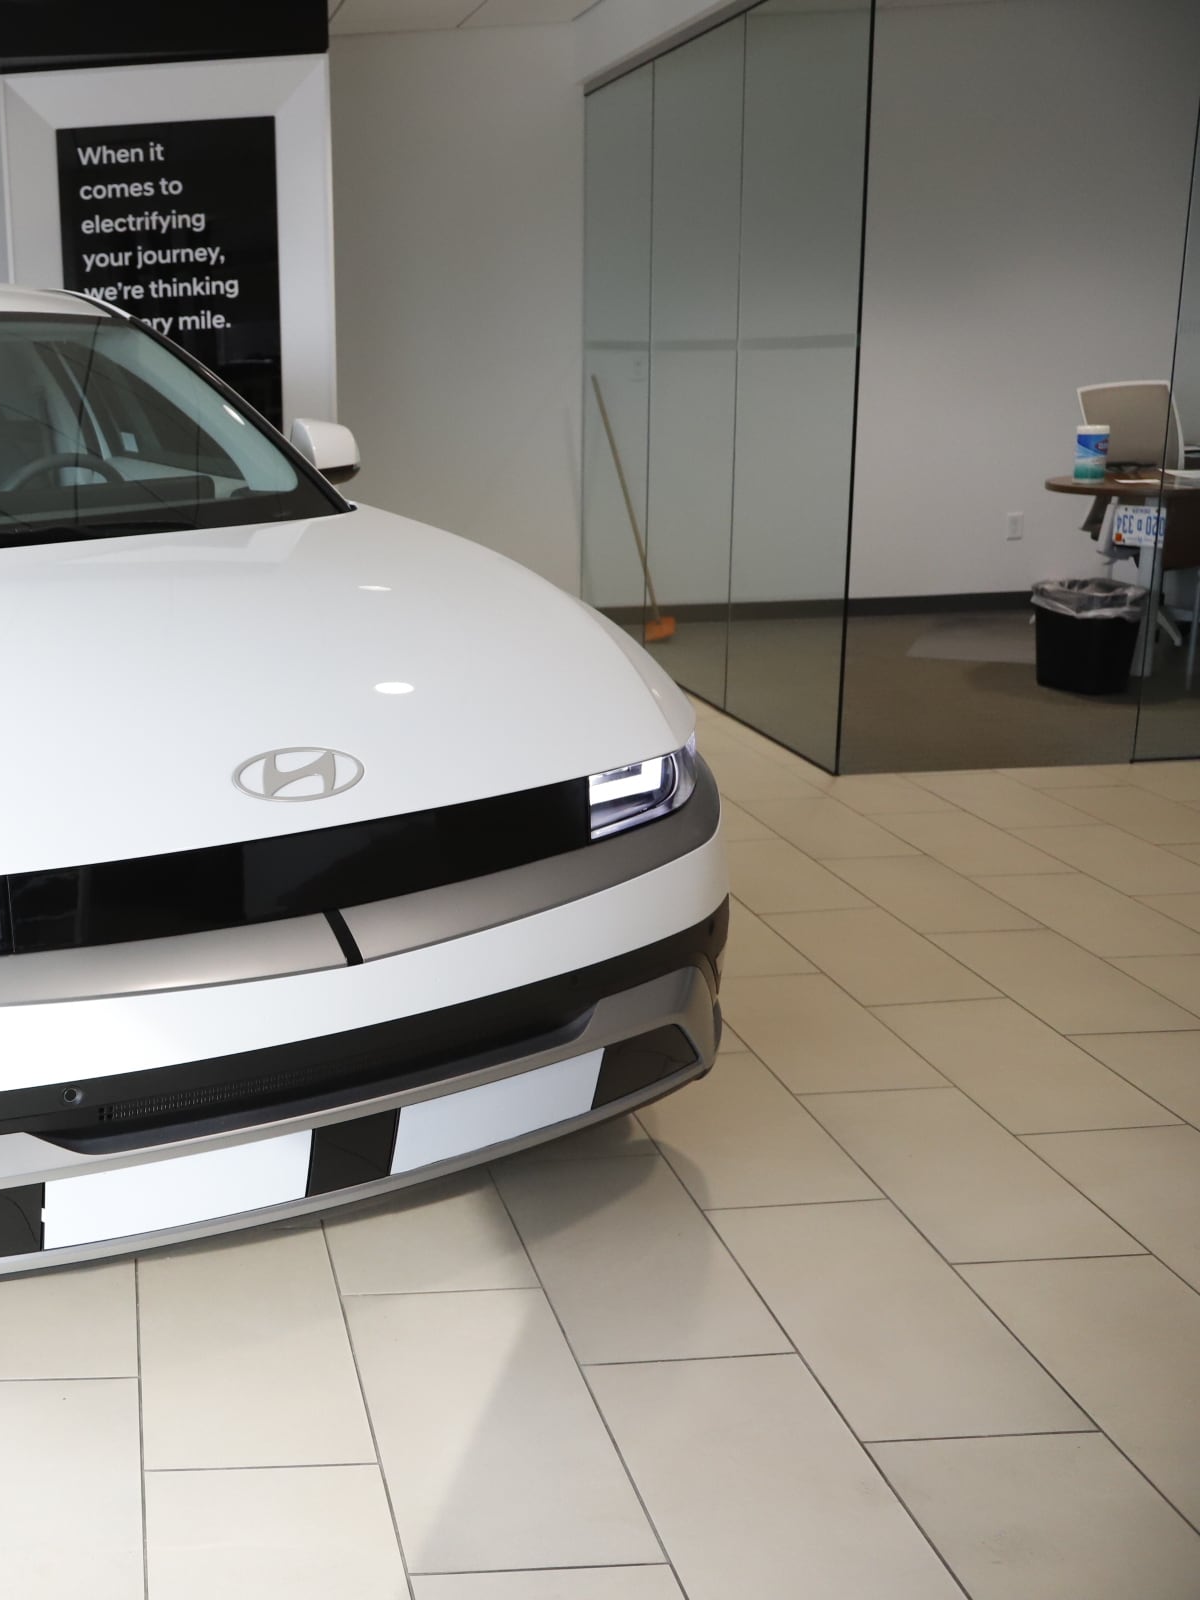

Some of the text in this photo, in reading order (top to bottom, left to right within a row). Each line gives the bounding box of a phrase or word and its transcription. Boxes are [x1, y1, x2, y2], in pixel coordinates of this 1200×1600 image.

[77, 142, 165, 166] When it
[79, 177, 183, 200] comes to
[81, 209, 206, 234] electrifying
[82, 245, 226, 272] your journey,
[148, 275, 239, 299] thinking
[178, 309, 232, 331] mile.
